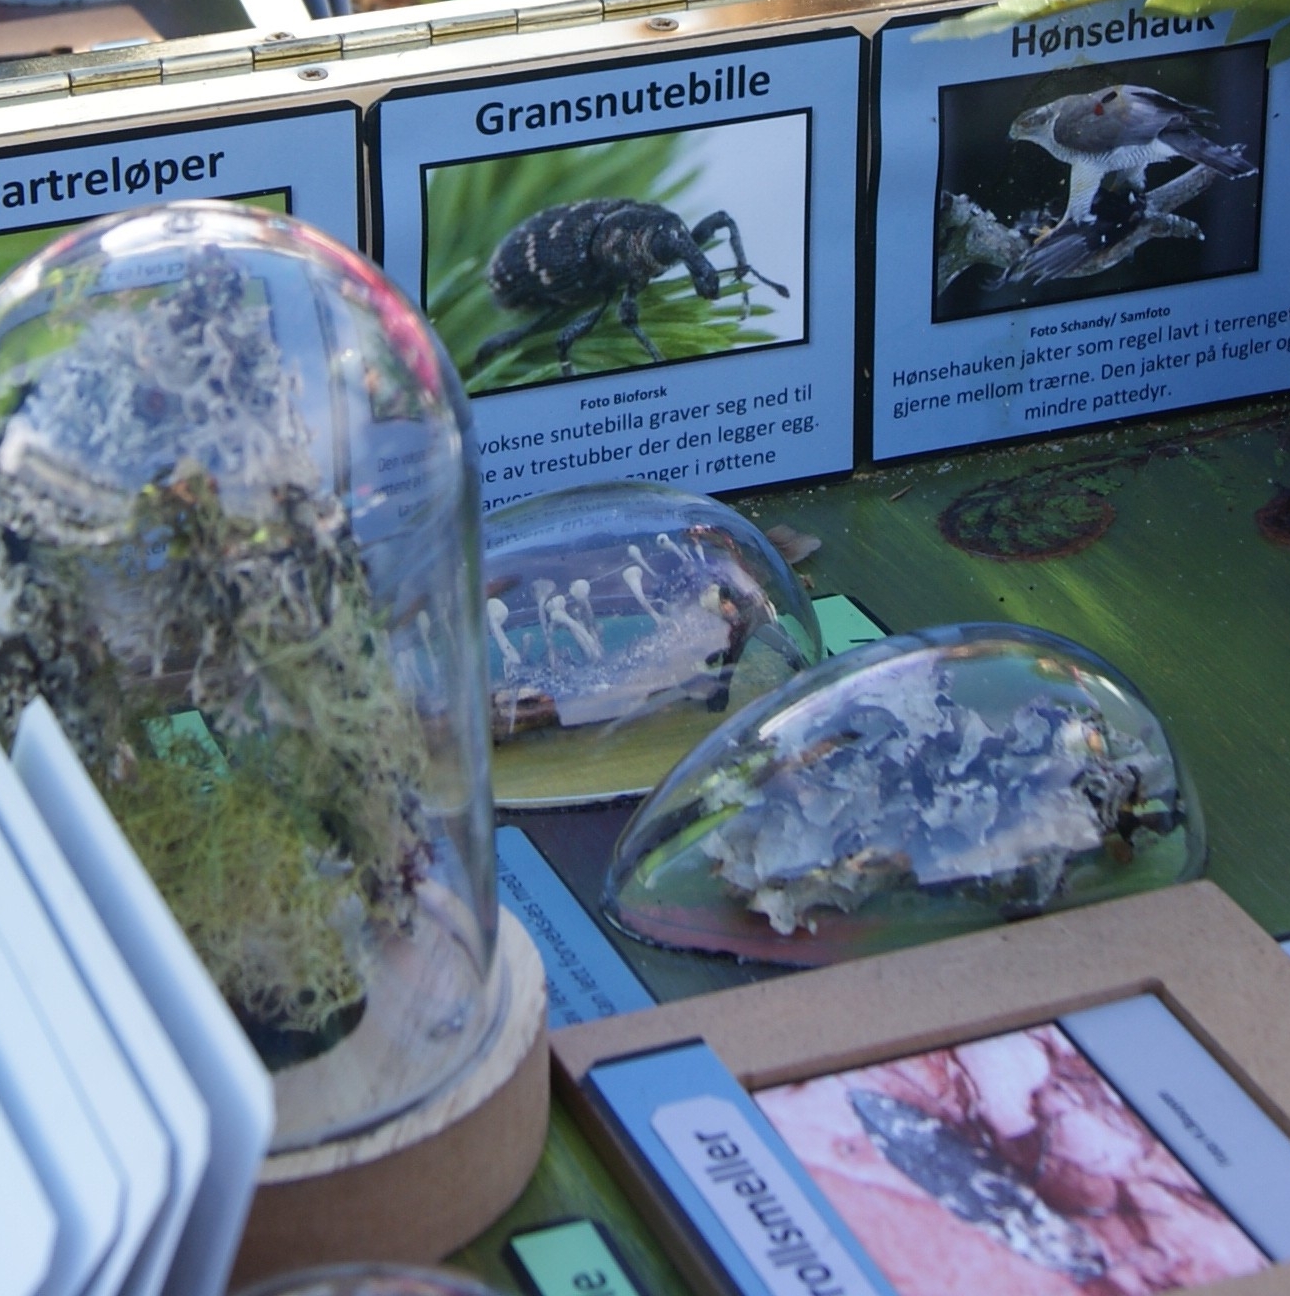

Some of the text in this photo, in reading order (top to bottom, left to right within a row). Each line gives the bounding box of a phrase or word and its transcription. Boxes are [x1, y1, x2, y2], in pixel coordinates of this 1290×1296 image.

[475, 64, 770, 135] Gransnutebille
[1030, 325, 1057, 337] Foto
[1120, 307, 1170, 323] Samfoto
[893, 355, 1014, 387] Hønsehauken
[1019, 345, 1071, 370] jakter
[1077, 339, 1112, 356] som
[1119, 326, 1161, 350] regel
[1168, 322, 1198, 340] lavt
[1204, 319, 1208, 334] i
[893, 394, 950, 419] gjerne
[956, 382, 1023, 404] mellom
[1028, 370, 1094, 392] trærne.
[1101, 363, 1134, 380] Den
[1139, 353, 1190, 377] jakter
[1196, 345, 1215, 367] på
[1221, 338, 1270, 360] fugler
[550, 412, 642, 442] snutebilla
[649, 404, 710, 429] graver
[716, 398, 746, 415] seg
[753, 387, 787, 408] ned
[794, 383, 811, 402] til
[580, 385, 667, 409] Foto Bioforsk
[1024, 383, 1171, 419] mindre pattedyr.
[503, 415, 818, 479] av trestubber der den legger egg.
[695, 450, 775, 475] i røttene
[695, 1130, 845, 1296] rollsmeller
